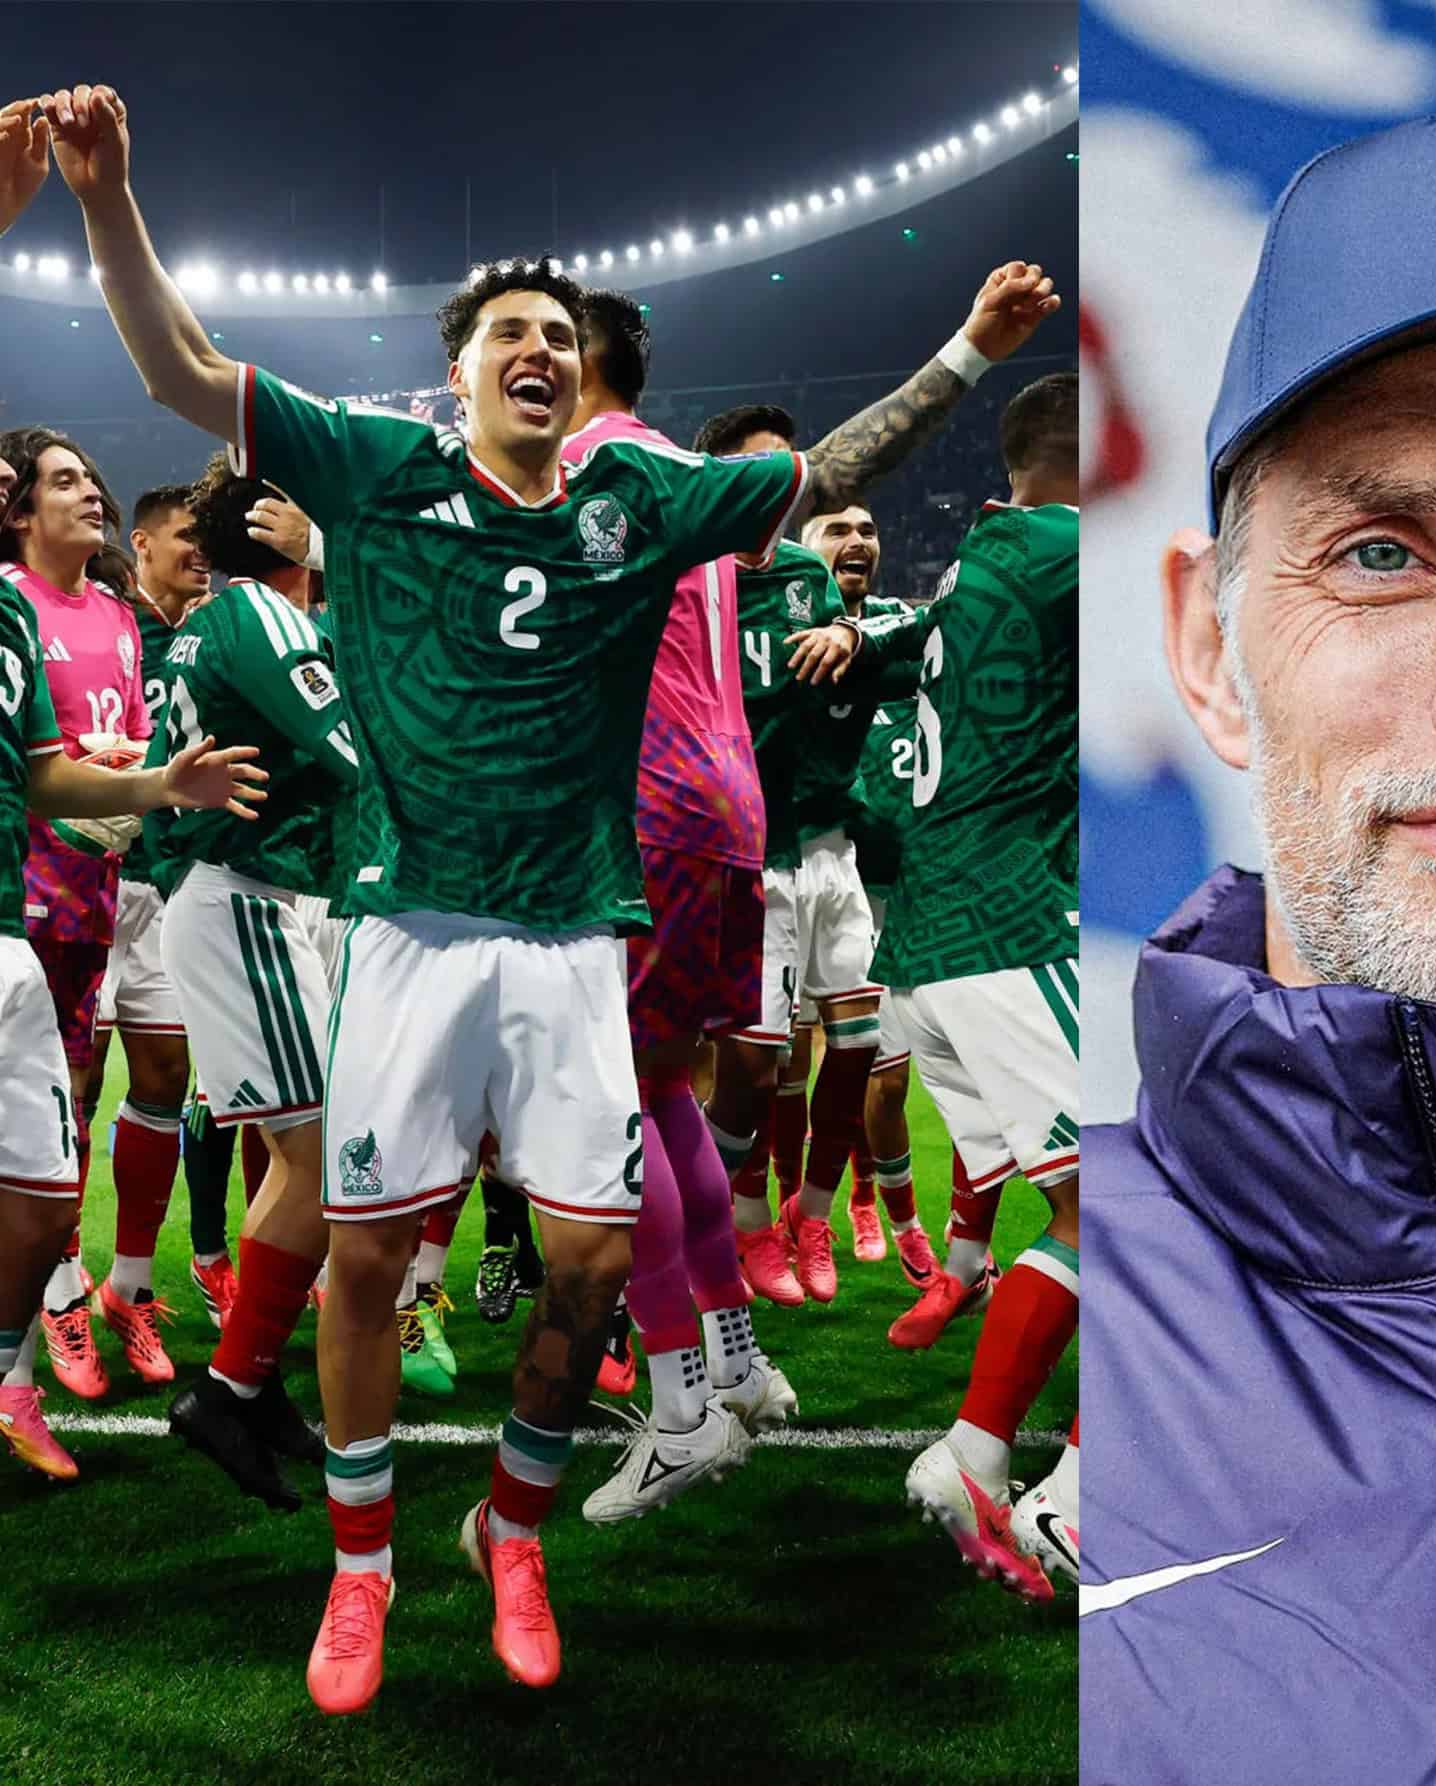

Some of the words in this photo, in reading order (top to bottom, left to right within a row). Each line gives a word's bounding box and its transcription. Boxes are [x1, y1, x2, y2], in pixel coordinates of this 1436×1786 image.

[500, 566, 547, 649] 2
[744, 631, 772, 687] 4
[86, 687, 123, 734] 12
[623, 1112, 643, 1195] 2
